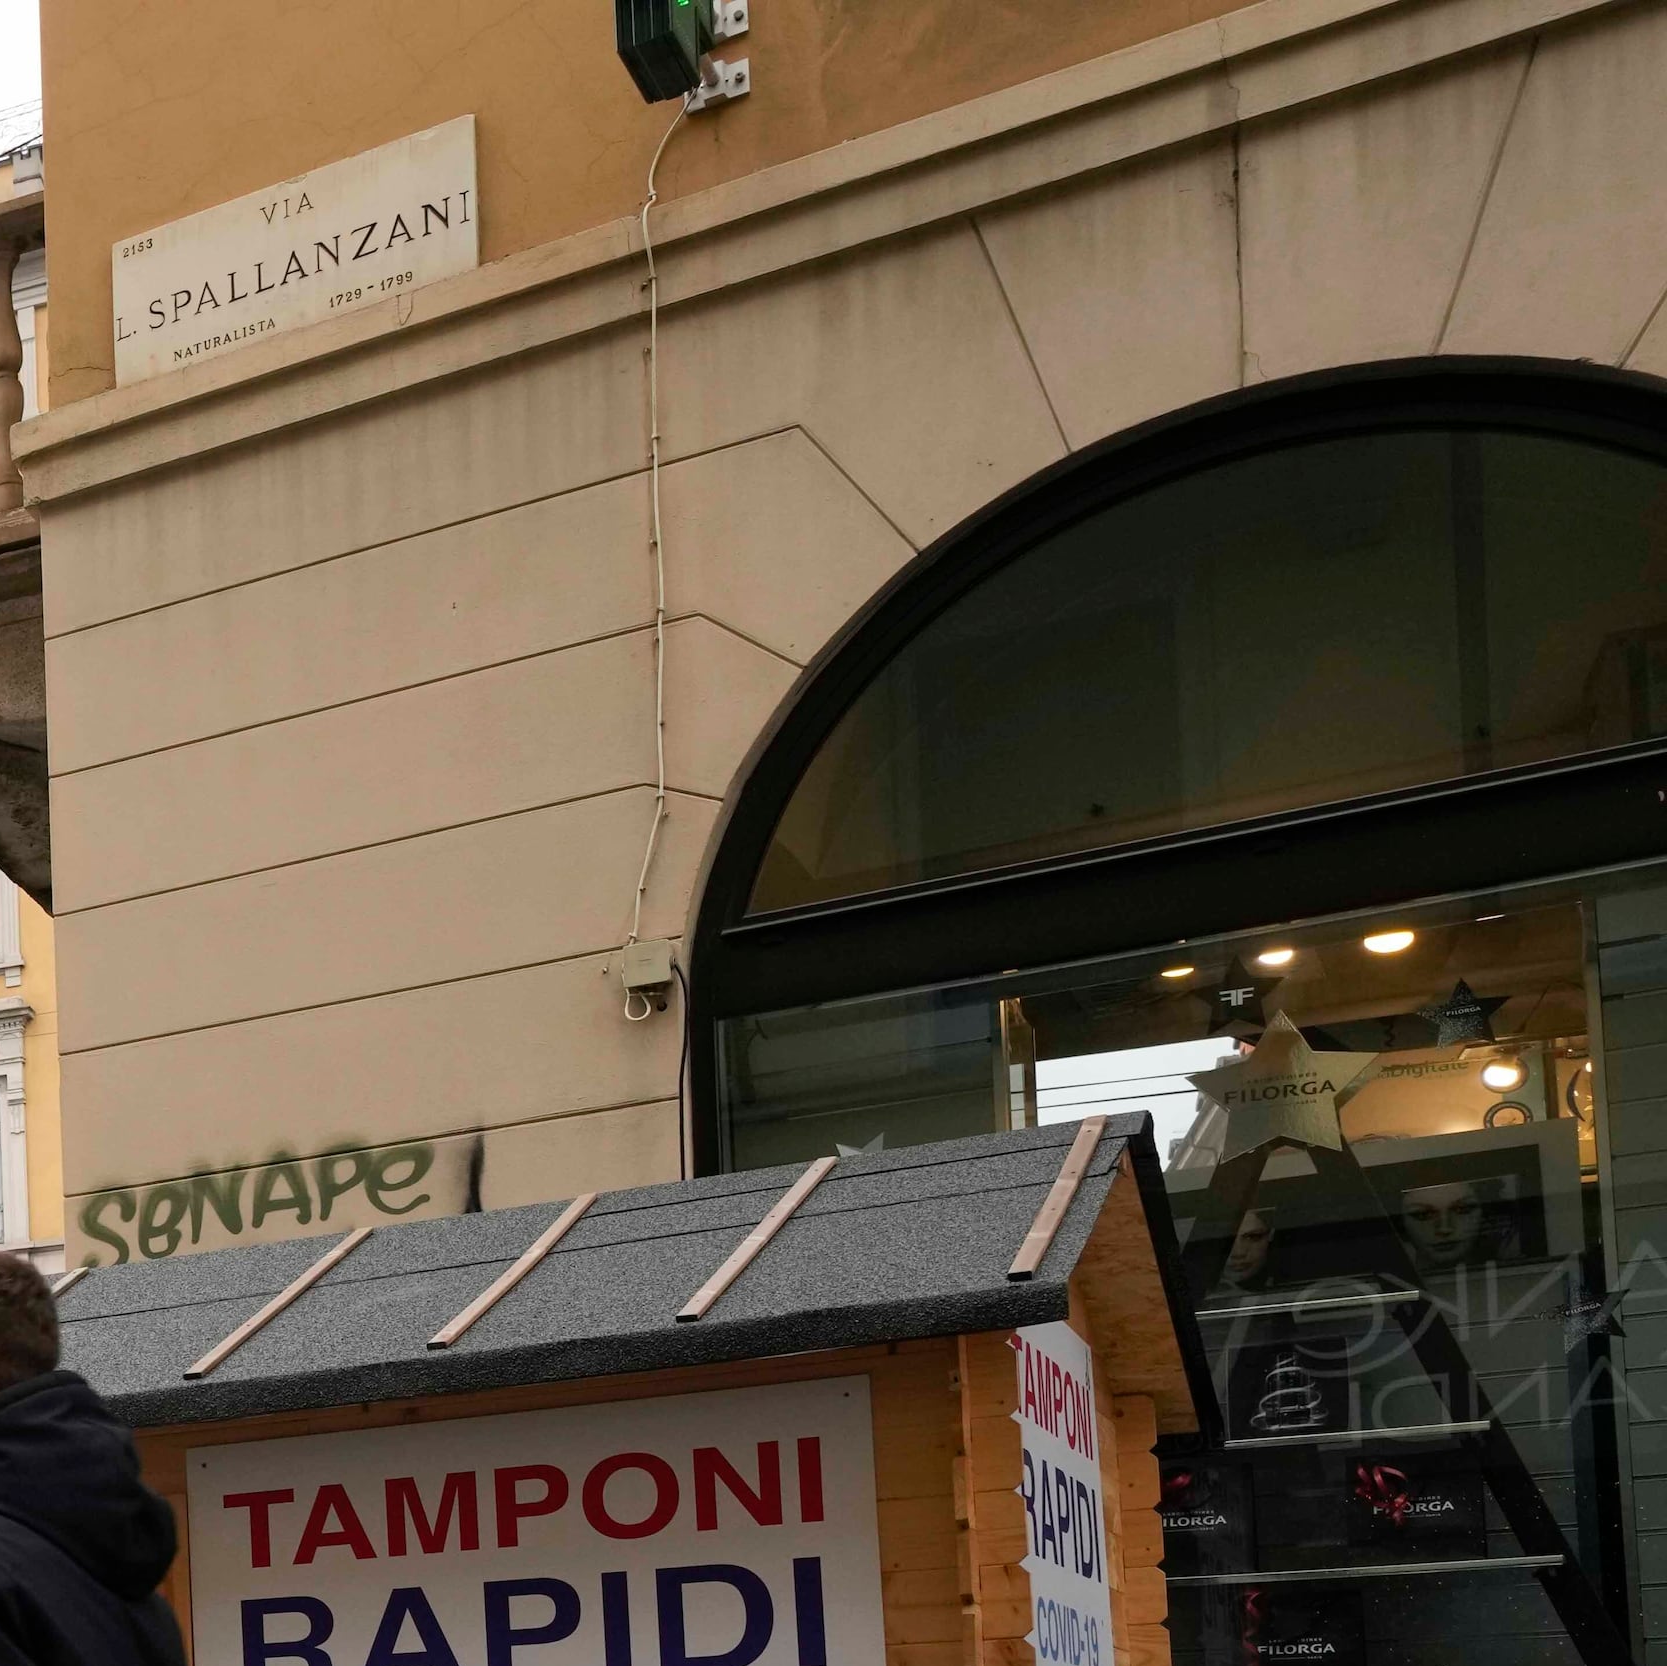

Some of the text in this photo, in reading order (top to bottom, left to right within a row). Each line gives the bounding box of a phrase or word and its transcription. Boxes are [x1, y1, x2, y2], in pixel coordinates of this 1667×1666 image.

[259, 193, 314, 224] VIA
[122, 238, 154, 258] 2153
[116, 190, 471, 342] L. SPALLANZANI
[328, 287, 363, 309] 1729
[379, 271, 415, 292] 1799
[173, 318, 277, 362] NATURALISTA
[1445, 1005, 1482, 1018] FILORGA
[1223, 1079, 1336, 1105] FILORGA
[1011, 1332, 1094, 1461] TAMPONI
[223, 1436, 825, 1569] TAMPONI
[1022, 1447, 1102, 1584] RAPIDI
[1373, 1500, 1455, 1515] FORGA
[1163, 1515, 1228, 1528] ILORGA
[1257, 1643, 1336, 1656] FILORGA
